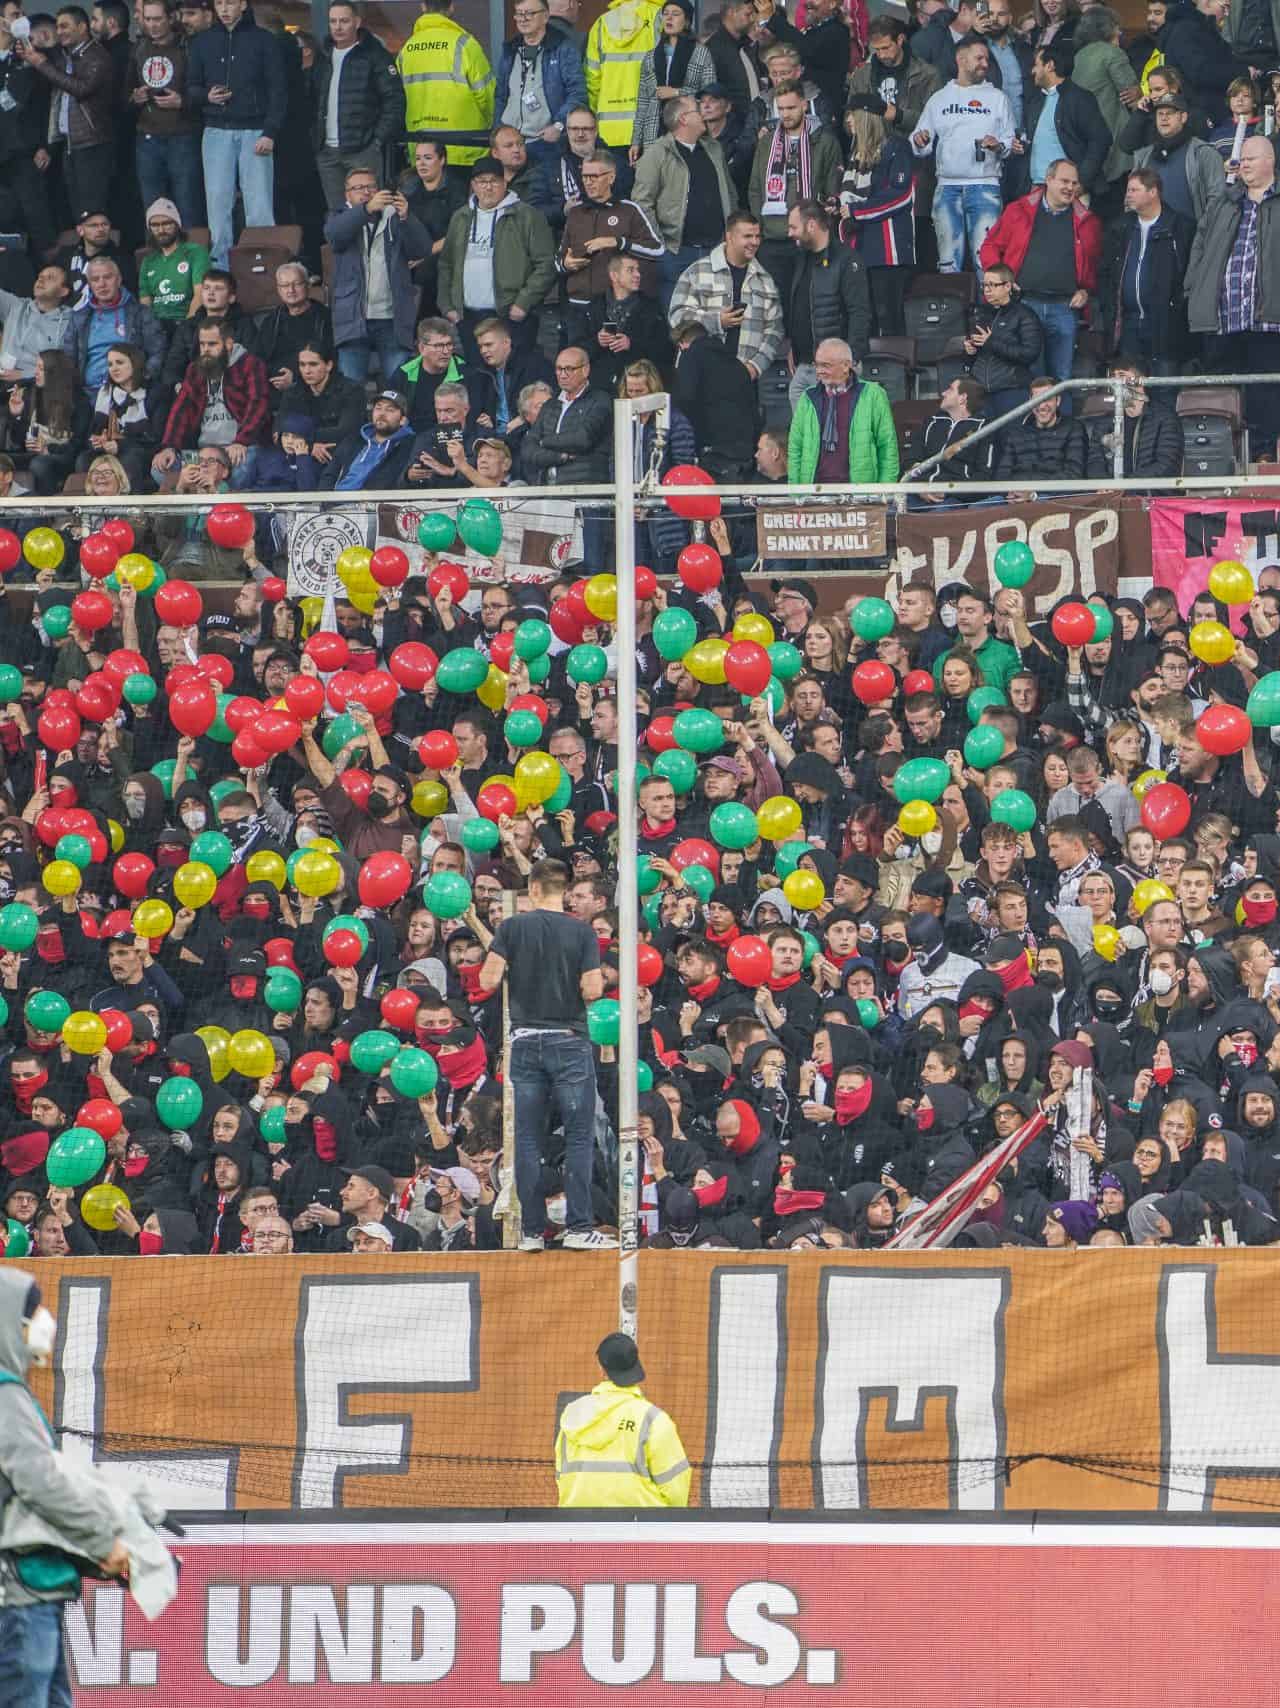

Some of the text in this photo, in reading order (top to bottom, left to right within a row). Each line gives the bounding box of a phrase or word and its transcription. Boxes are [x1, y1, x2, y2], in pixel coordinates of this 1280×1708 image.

[406, 41, 449, 53] ORDNER
[942, 103, 991, 116] ellesse
[763, 511, 867, 529] GRENZENLOS
[767, 534, 868, 551] SANKT PAULI
[1183, 511, 1228, 558] IF
[205, 1582, 457, 1687] UND
[498, 1580, 840, 1688] PULS.
